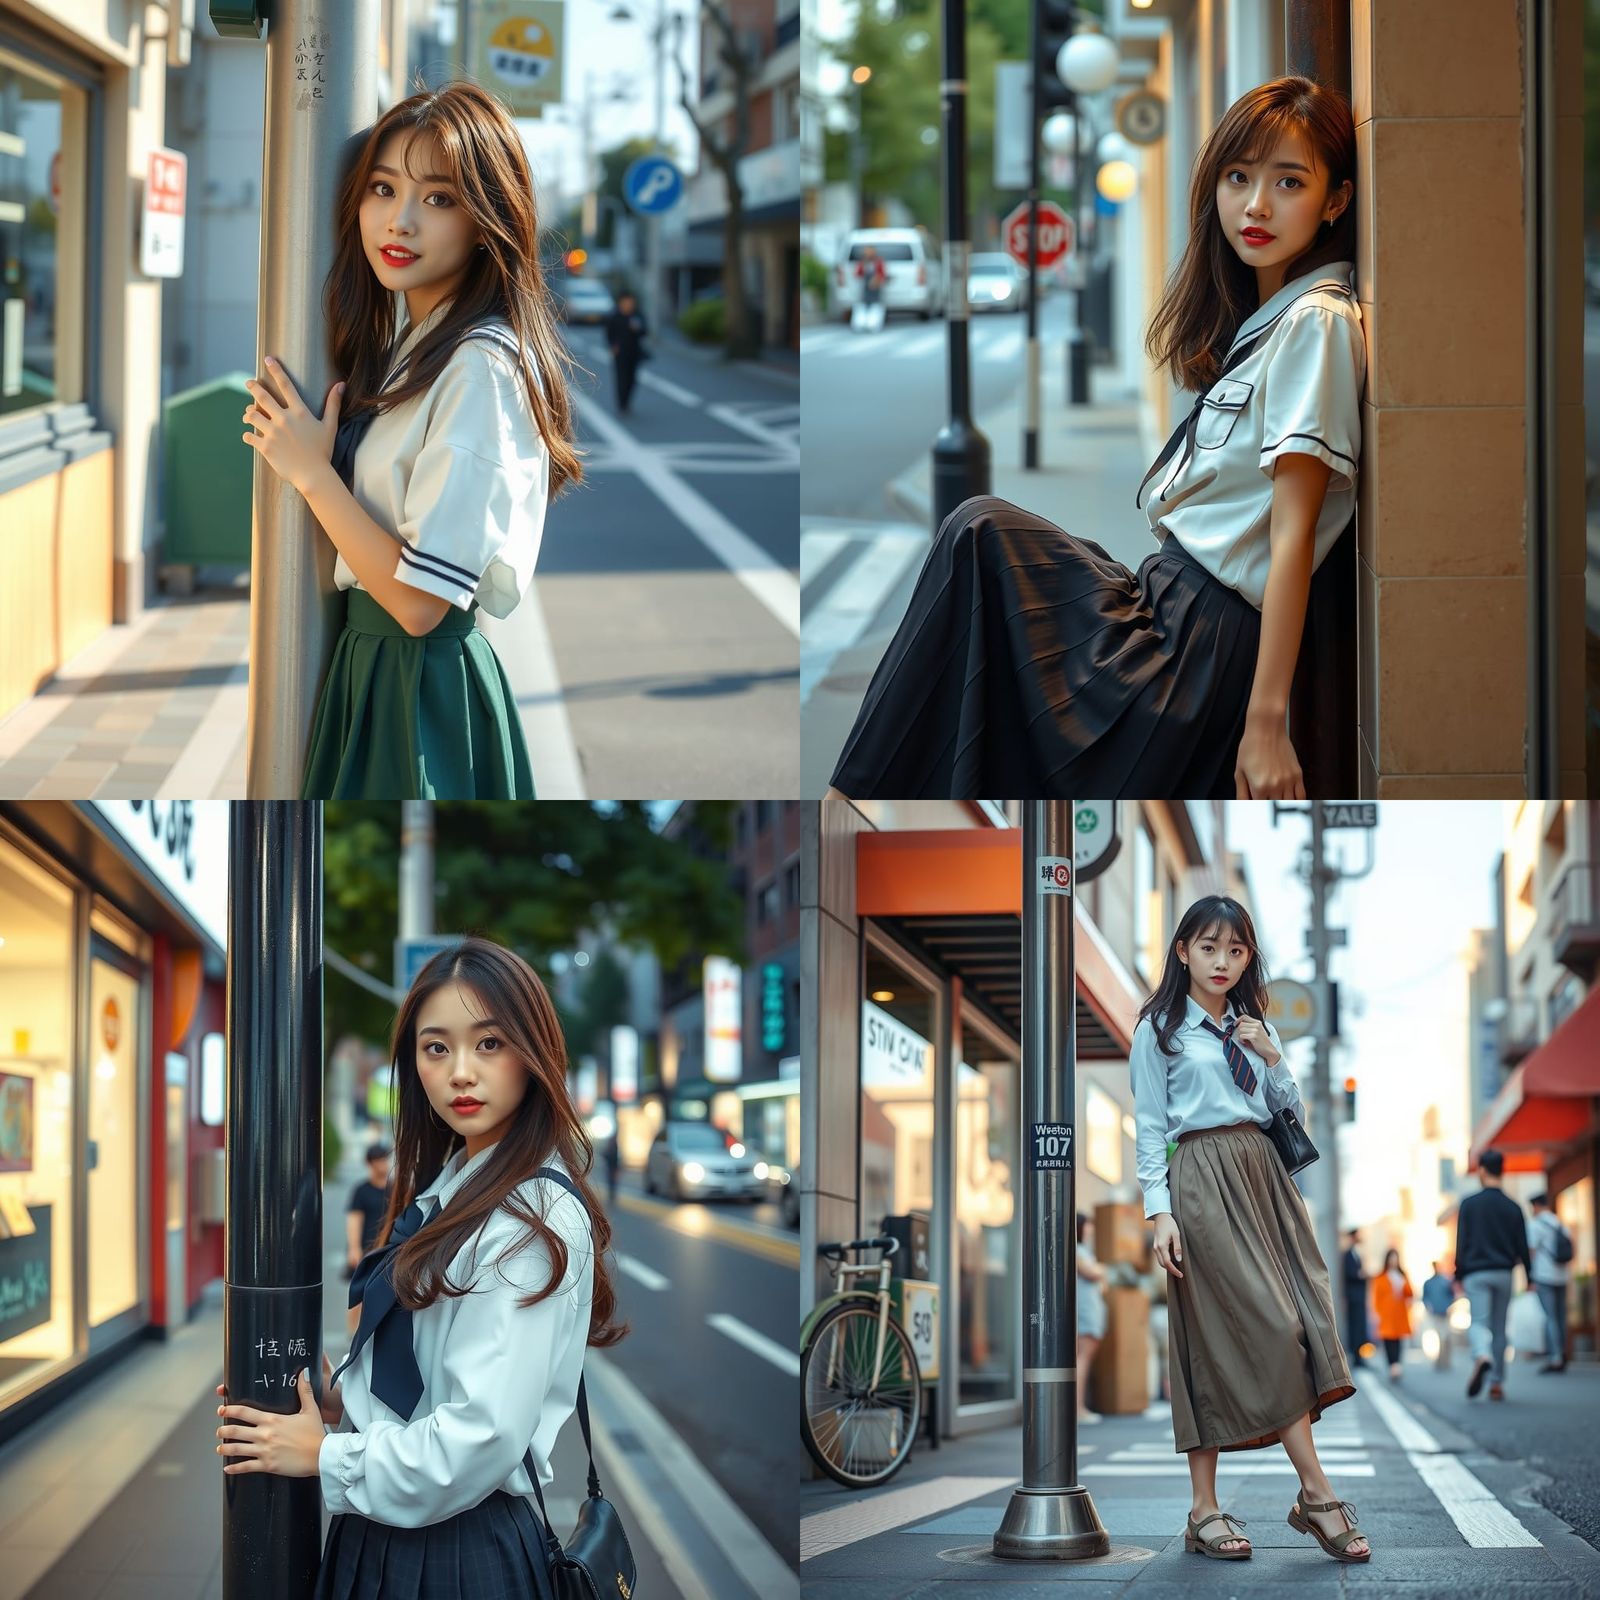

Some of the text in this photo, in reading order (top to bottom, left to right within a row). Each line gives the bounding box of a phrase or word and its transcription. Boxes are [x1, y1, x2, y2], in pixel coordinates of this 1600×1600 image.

[1014, 224, 1063, 253] SOP
[1322, 806, 1376, 826] YALE
[1035, 1136, 1071, 1157] 107
